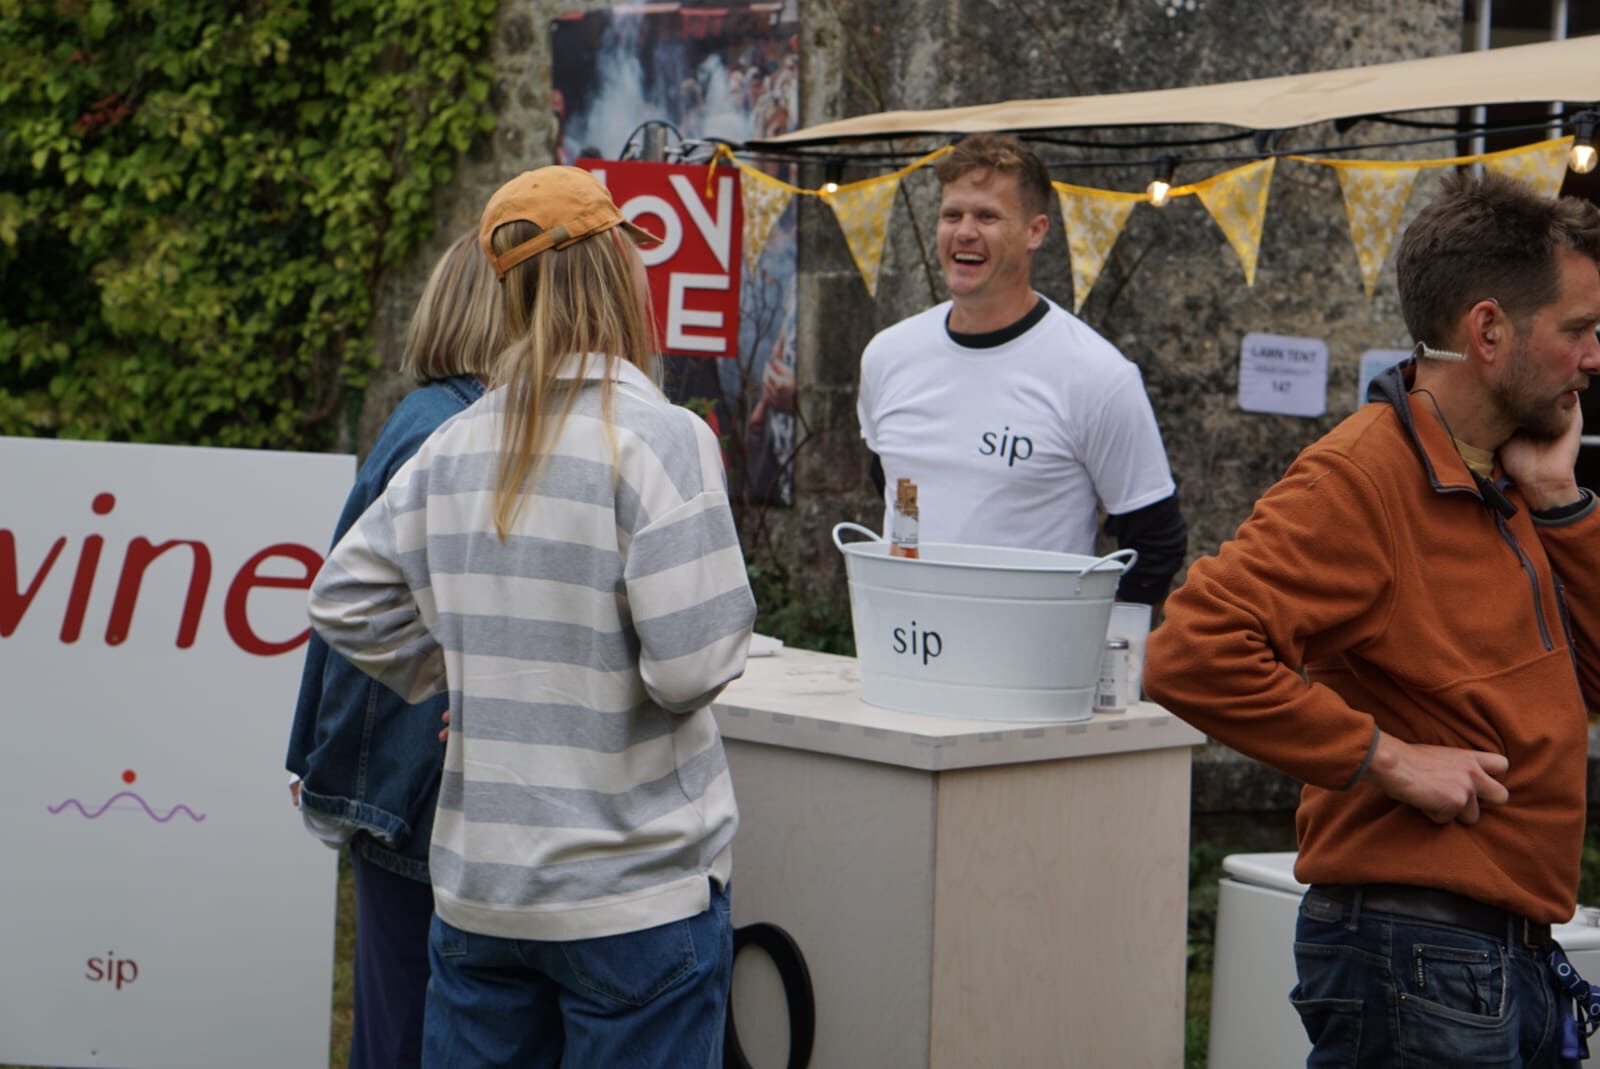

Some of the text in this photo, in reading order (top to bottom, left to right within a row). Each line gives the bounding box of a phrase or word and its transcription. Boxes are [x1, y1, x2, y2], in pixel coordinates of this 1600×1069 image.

[979, 426, 1033, 467] sip
[893, 620, 942, 665] sip
[85, 950, 139, 990] sip
